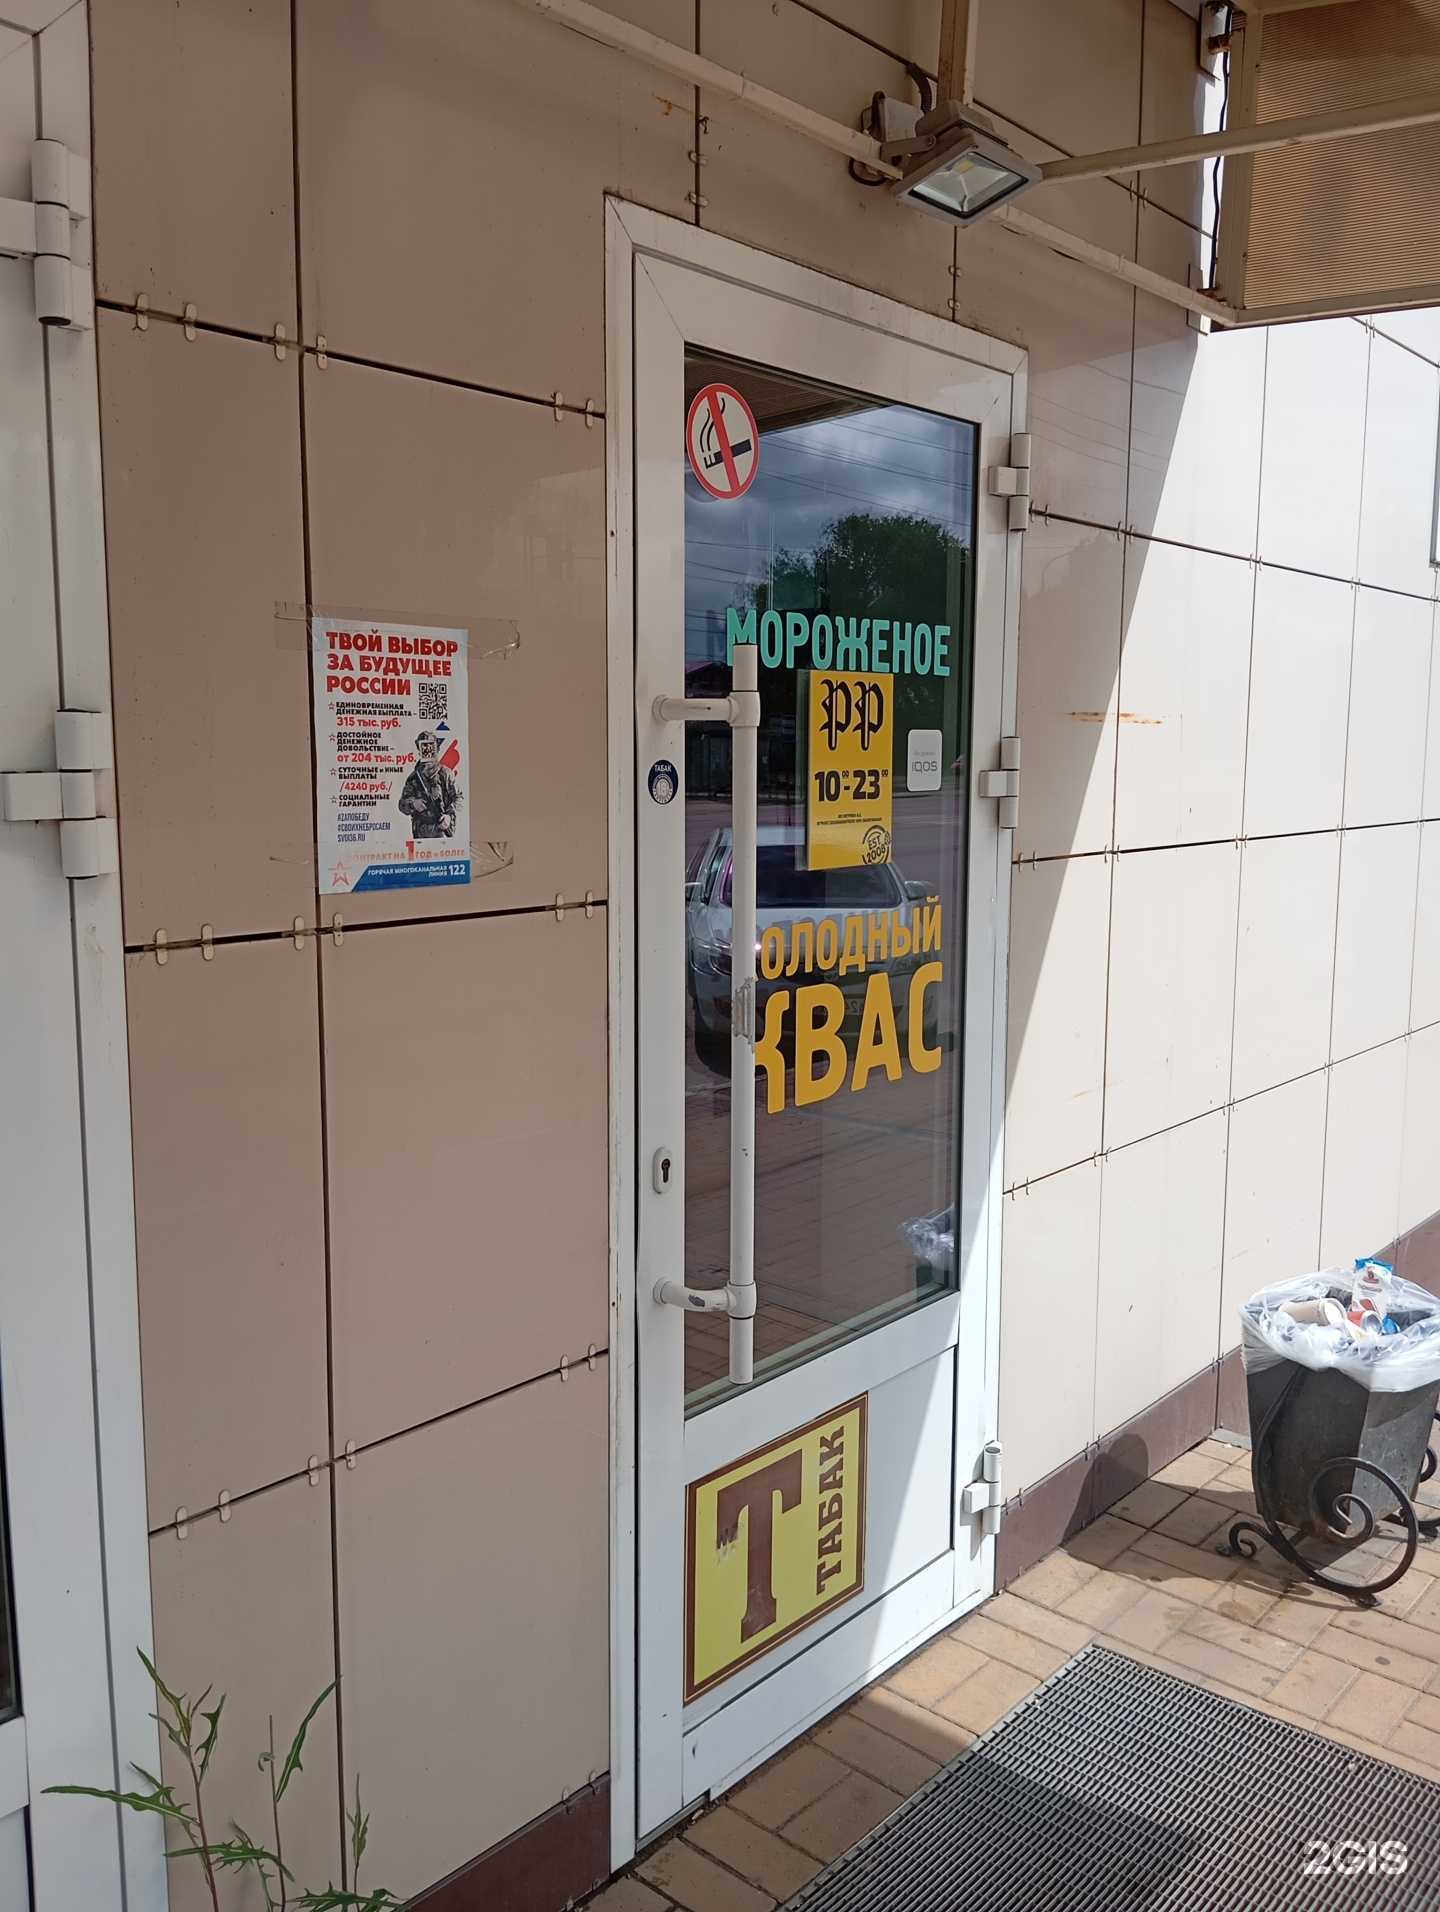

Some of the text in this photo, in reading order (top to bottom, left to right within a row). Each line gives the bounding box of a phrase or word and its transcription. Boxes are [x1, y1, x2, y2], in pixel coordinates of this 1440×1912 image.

[326, 629, 459, 657] ТВОЙ ВЫБОР
[727, 608, 951, 677] МОРОЖЕНОЕ
[327, 653, 452, 678] ЗА БУДУЩЕЕ
[326, 675, 411, 696] РОССИИ
[336, 701, 404, 710] ЕДИНОВРЕМЕННАЯ
[336, 716, 402, 730] 315 тыс. руб.
[336, 731, 382, 739] ДОСТОЙНОЕ
[337, 752, 417, 766] от 204 тыс. руб.
[339, 794, 390, 802] СОЦИАЛЬНЫЕ
[868, 835, 881, 849] EST
[405, 841, 415, 861] 1
[448, 864, 466, 875] 122
[756, 896, 943, 982] ОЛОДНЫЙ
[815, 1424, 845, 1596] ТАБАК
